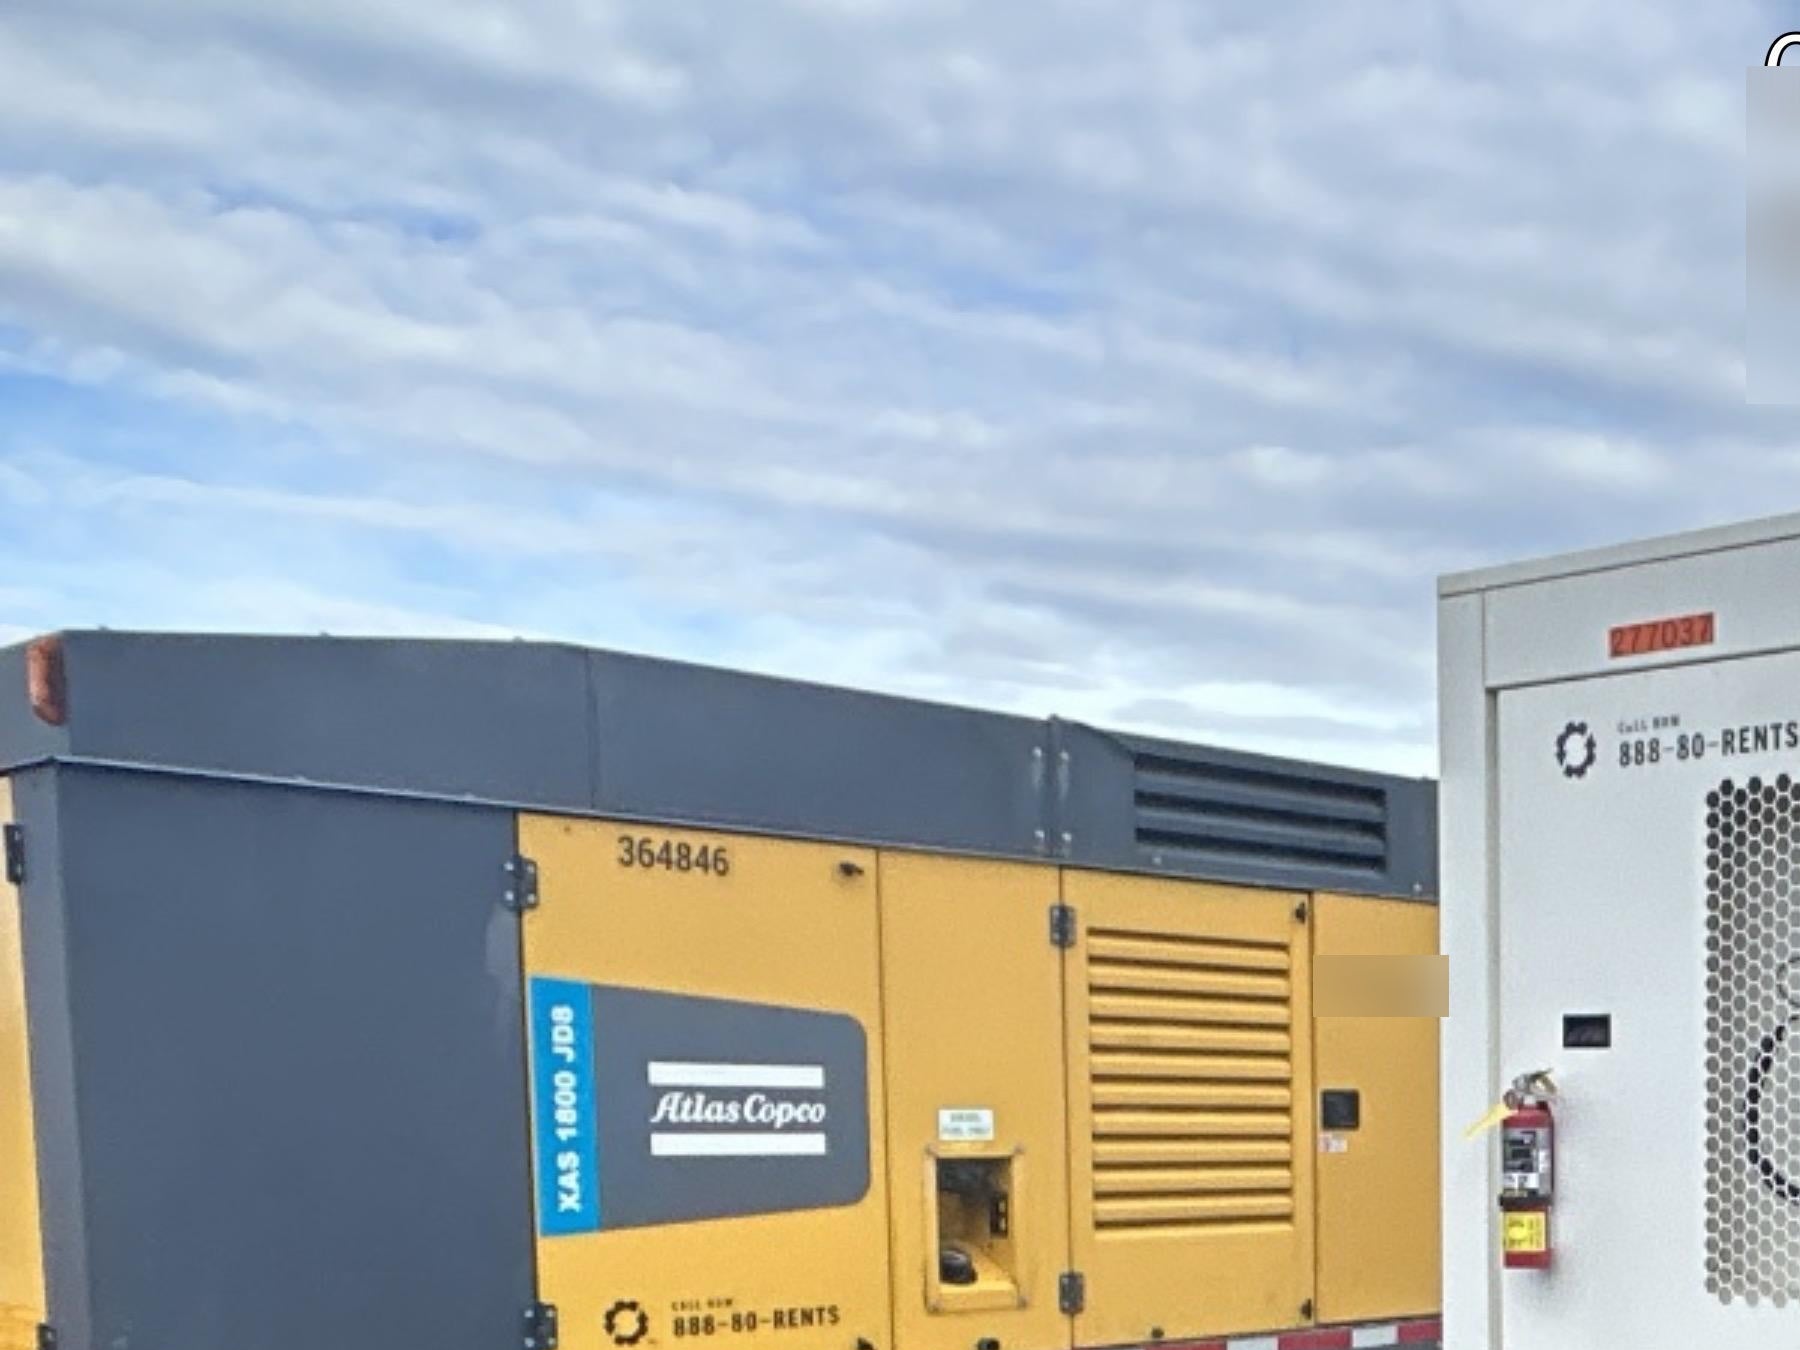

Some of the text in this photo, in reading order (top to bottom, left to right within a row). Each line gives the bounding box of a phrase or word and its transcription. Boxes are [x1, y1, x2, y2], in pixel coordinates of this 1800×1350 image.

[1618, 721, 1800, 768] 888-80-RENTS
[617, 835, 729, 876] 364846
[553, 1071, 579, 1142] 1800
[649, 1091, 827, 1129] Atlas Copco
[556, 1151, 583, 1213] XAS
[673, 1305, 841, 1338] 888-80-RENTS
